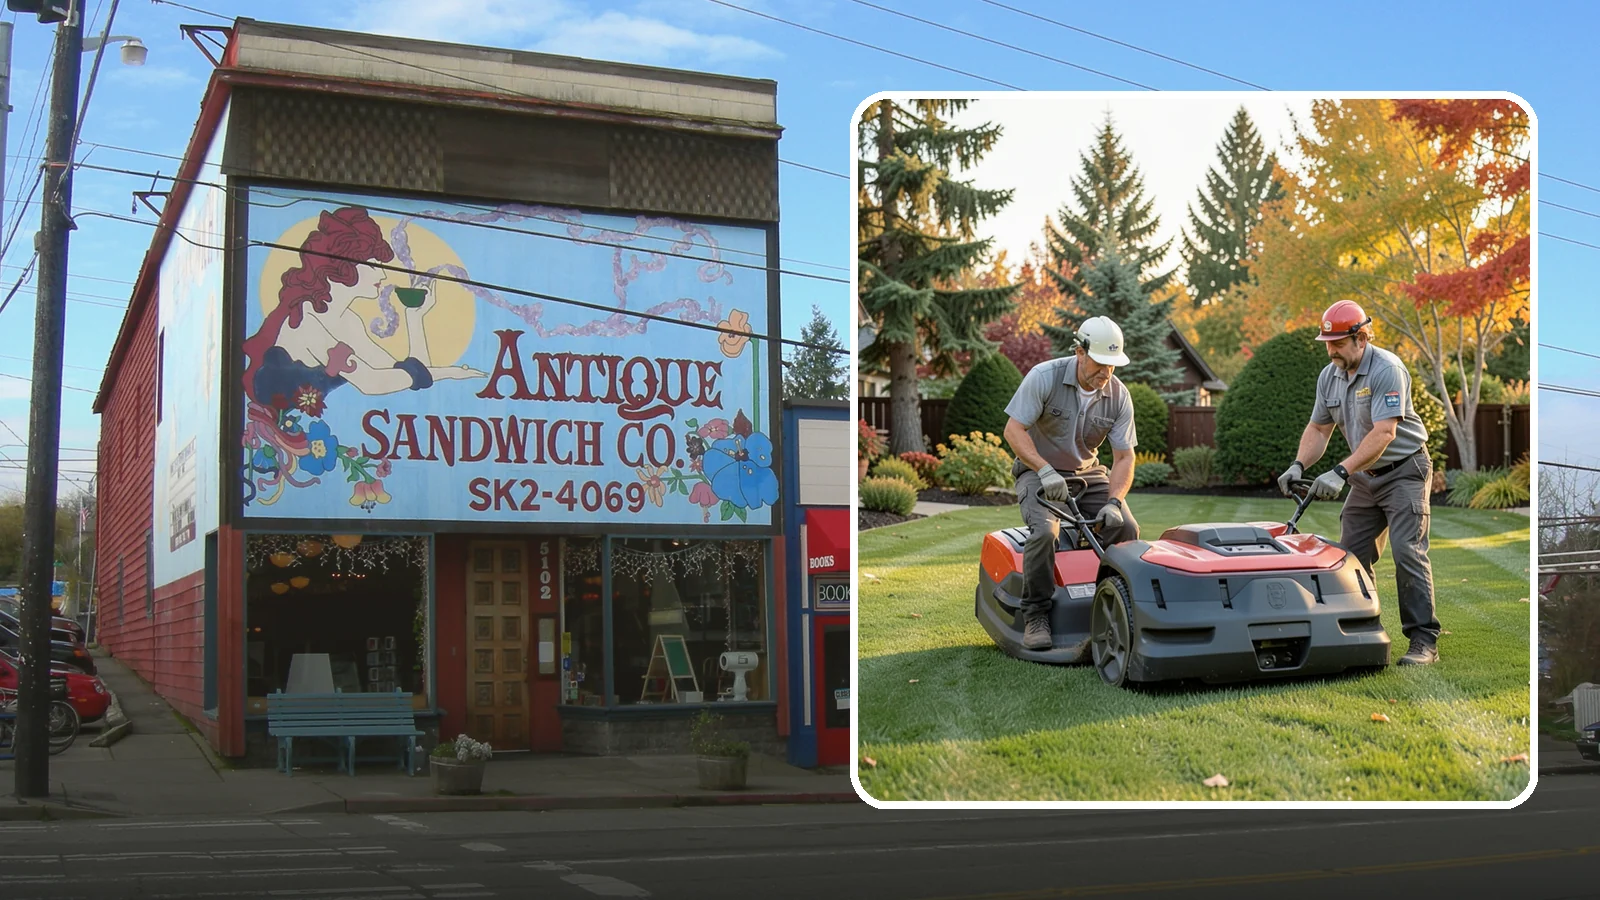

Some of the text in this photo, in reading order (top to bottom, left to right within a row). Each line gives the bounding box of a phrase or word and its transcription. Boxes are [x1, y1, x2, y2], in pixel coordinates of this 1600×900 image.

[475, 328, 723, 420] ANTIQUE
[361, 408, 685, 469] SANDWICH CO.
[469, 477, 645, 513] SK2-4069
[540, 541, 551, 600] 5102
[809, 555, 835, 569] BOOKS
